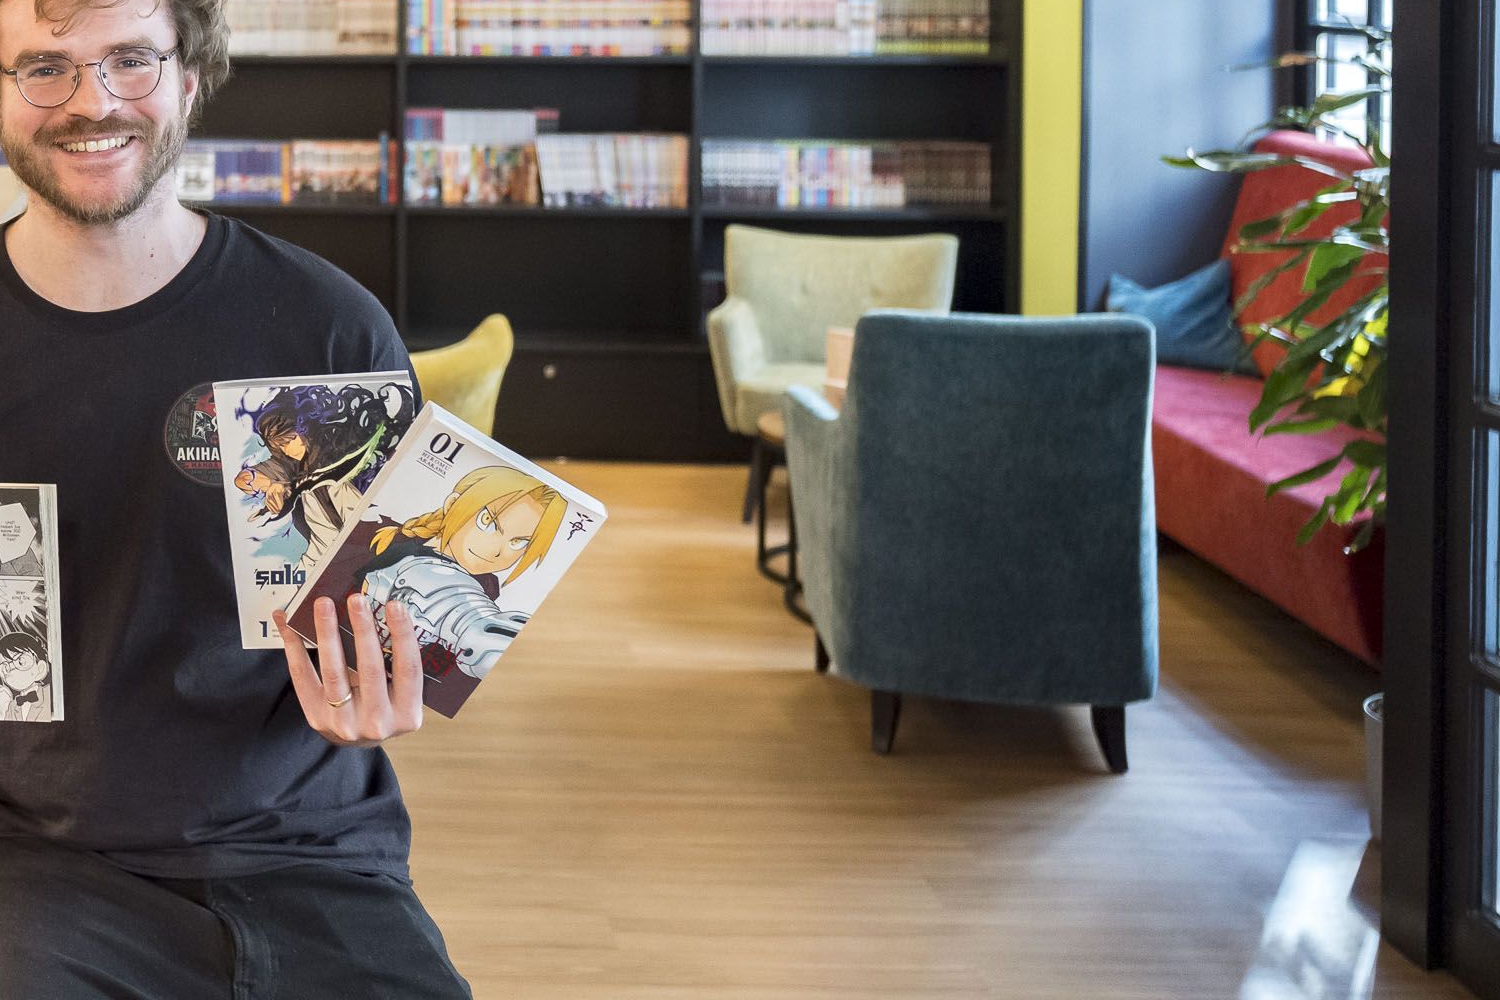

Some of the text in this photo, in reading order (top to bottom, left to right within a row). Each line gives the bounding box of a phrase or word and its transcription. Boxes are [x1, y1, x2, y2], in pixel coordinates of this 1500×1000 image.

[429, 432, 465, 464] 01
[419, 456, 446, 476] ARAKAWA
[422, 451, 450, 471] HIROMU
[254, 563, 306, 591] solo
[259, 620, 268, 638] 1
